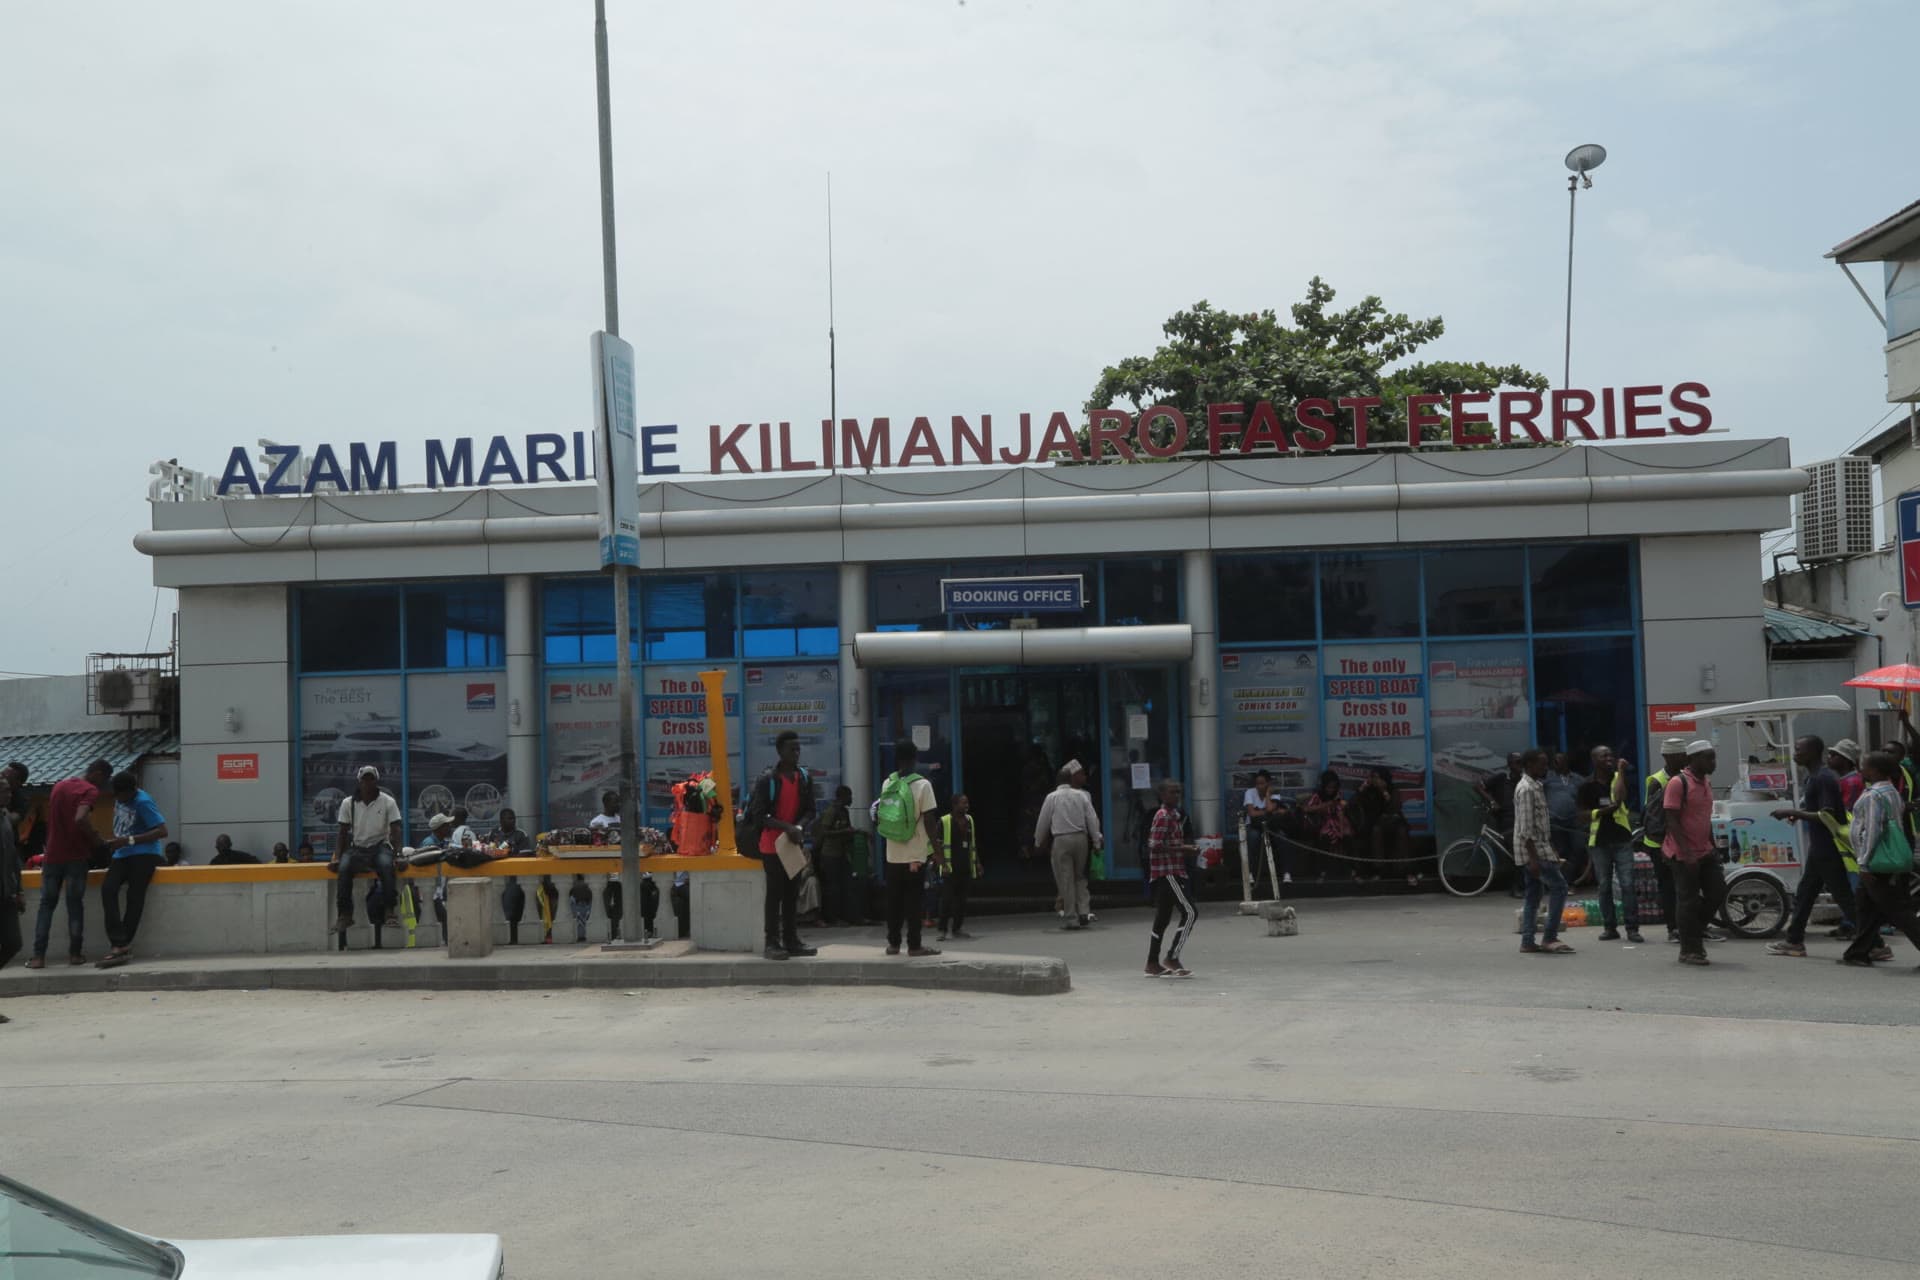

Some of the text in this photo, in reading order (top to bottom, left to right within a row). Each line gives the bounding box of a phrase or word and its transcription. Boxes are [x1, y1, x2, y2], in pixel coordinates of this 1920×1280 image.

[216, 440, 398, 496] AZAM
[424, 424, 681, 487] MARIE
[709, 404, 1189, 475] KILIMANJARO
[1207, 396, 1382, 455] FAST
[1407, 381, 1713, 447] FERRIES
[952, 589, 1073, 603] BOOKING OFFICE
[1340, 658, 1406, 675] The only
[576, 682, 613, 697] KLM
[660, 679, 687, 694] The
[1330, 678, 1419, 696] SPEED BOAT
[313, 692, 372, 704] The BEST
[651, 698, 735, 714] SPEED BT
[1342, 701, 1407, 717] Cross to
[662, 720, 704, 736] Cross
[1339, 721, 1411, 738] ZANZIBAR
[658, 740, 712, 756] ZANZIB
